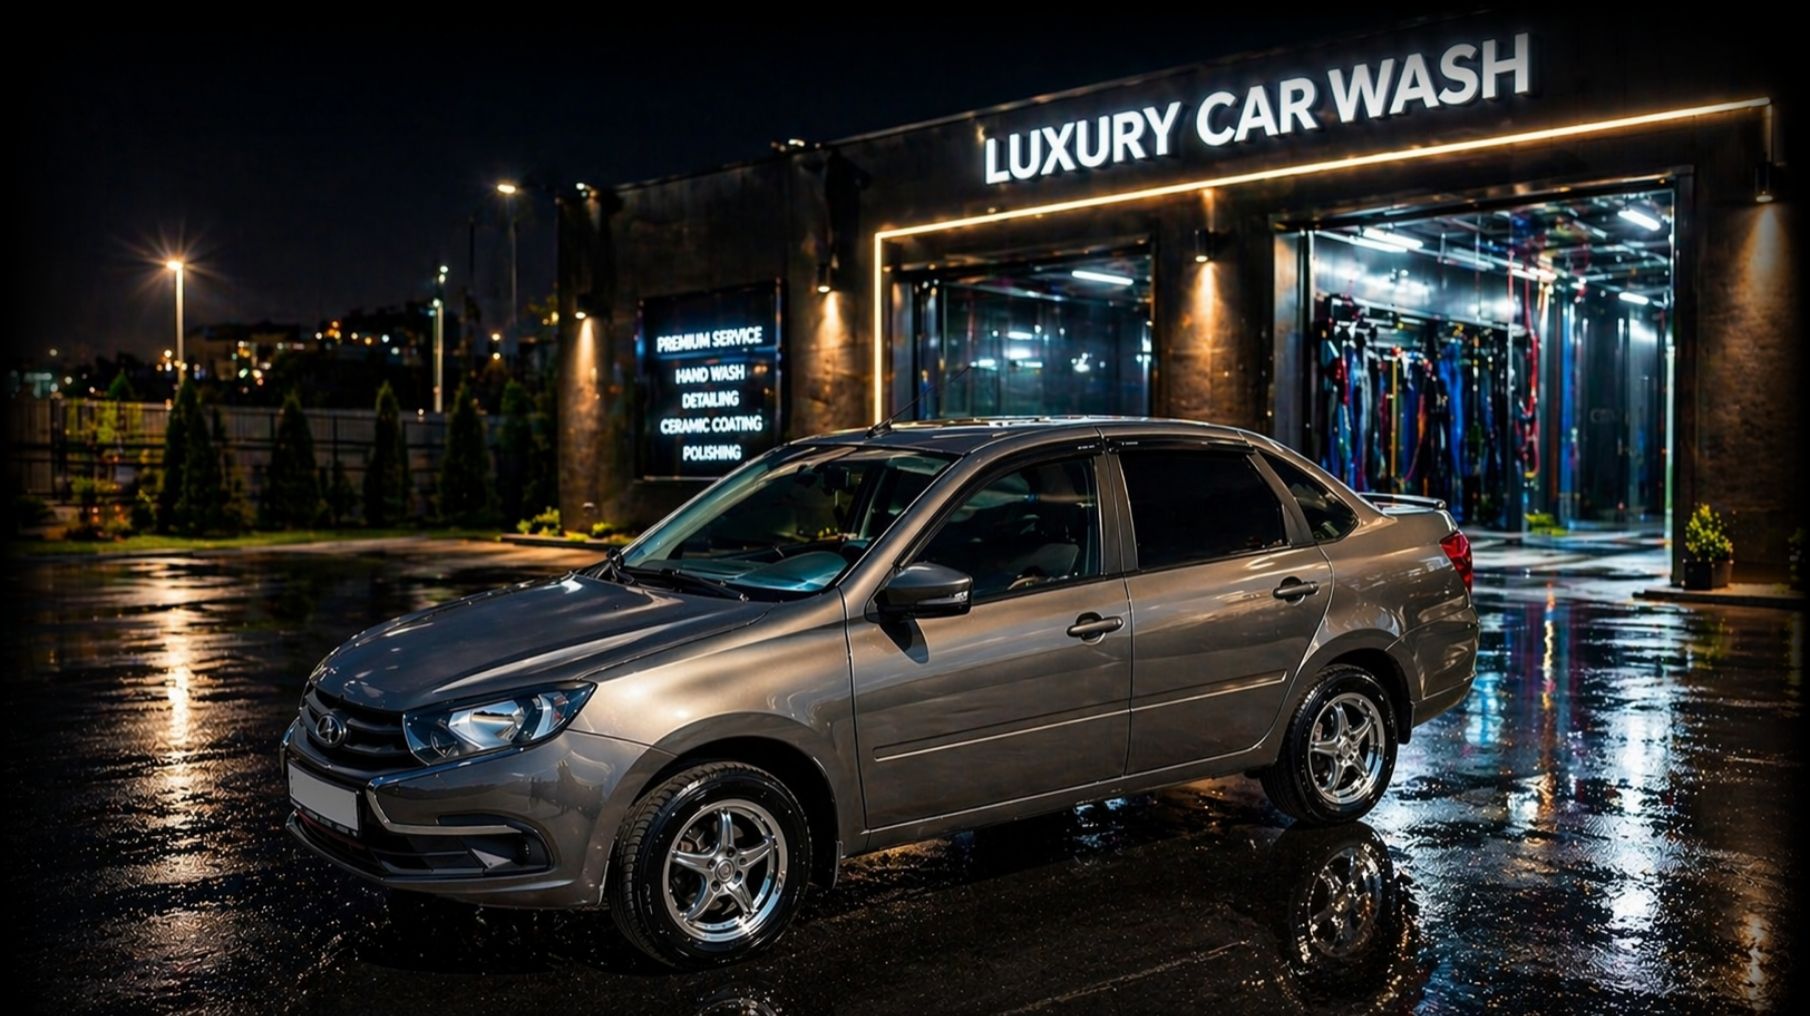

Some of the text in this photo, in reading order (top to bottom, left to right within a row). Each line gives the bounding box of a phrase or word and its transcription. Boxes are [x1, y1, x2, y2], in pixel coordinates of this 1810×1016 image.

[985, 32, 1530, 185] LUXURY CAR WASH
[656, 326, 763, 353] PREMIUM SERVICE
[675, 364, 745, 384] HAND WASH
[682, 390, 740, 409] DETAILING
[660, 415, 763, 434] CERAMIC COATING
[682, 444, 742, 461] POLISHING
